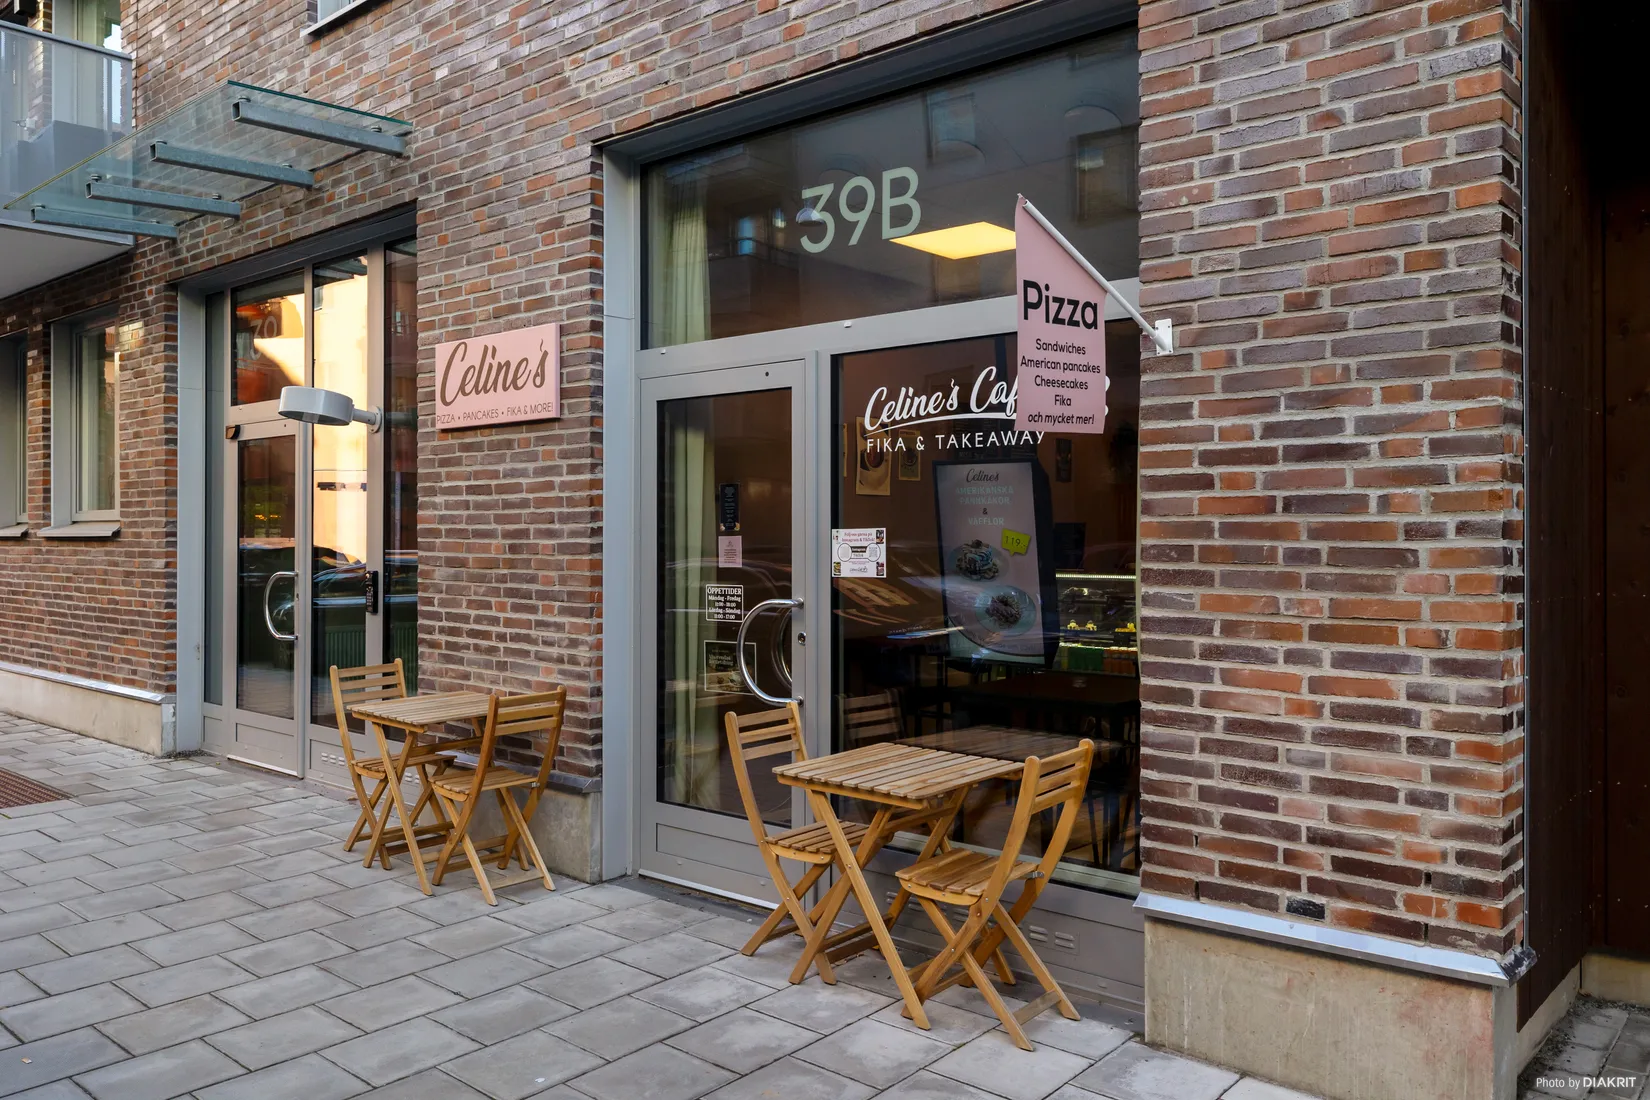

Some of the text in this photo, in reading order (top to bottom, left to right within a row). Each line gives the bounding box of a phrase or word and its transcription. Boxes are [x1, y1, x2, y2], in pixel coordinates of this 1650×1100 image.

[800, 166, 921, 254] 39B
[1023, 279, 1098, 330] Pizza
[1035, 338, 1086, 355] Sandwiches
[440, 338, 549, 407] Celine's
[1020, 355, 1101, 374] American pancakes
[1034, 375, 1089, 390] Cheesecakes
[864, 366, 1018, 431] Celine's Caf
[1054, 394, 1072, 407] Fika
[437, 402, 553, 424] PIZZA PANCAKES FIKA & MORE!
[1027, 412, 1095, 426] och mycket mer!
[867, 431, 1045, 453] FIKA & TAKEAWAY
[966, 468, 1000, 483] Celine's
[956, 486, 1014, 495] AMERIKANSKA
[960, 496, 1010, 505] PANNKAKOR
